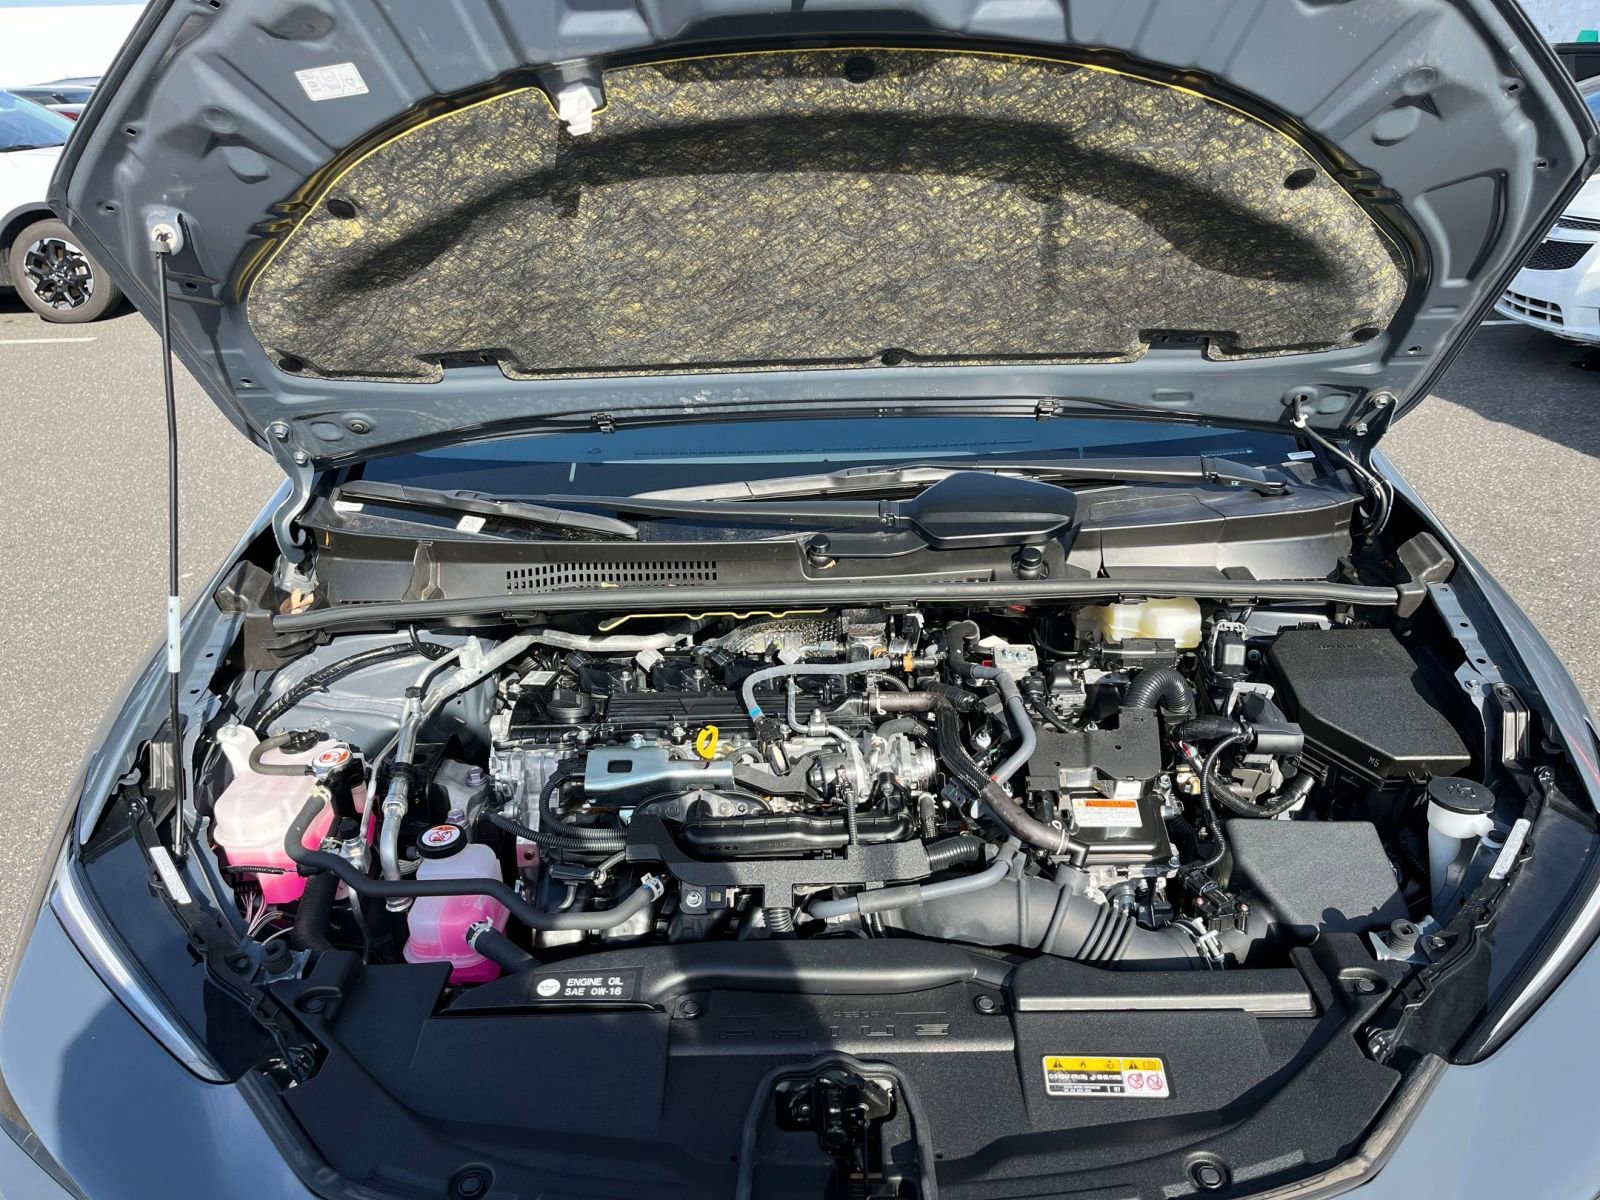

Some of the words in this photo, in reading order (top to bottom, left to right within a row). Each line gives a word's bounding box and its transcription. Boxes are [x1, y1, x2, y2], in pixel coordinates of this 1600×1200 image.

[1368, 756, 1380, 768] M5
[566, 978, 602, 986] ENGINE
[608, 977, 623, 985] OIL
[564, 988, 584, 996] SAE
[591, 987, 621, 996] 0W-16
[719, 1023, 950, 1040] PRIUS
